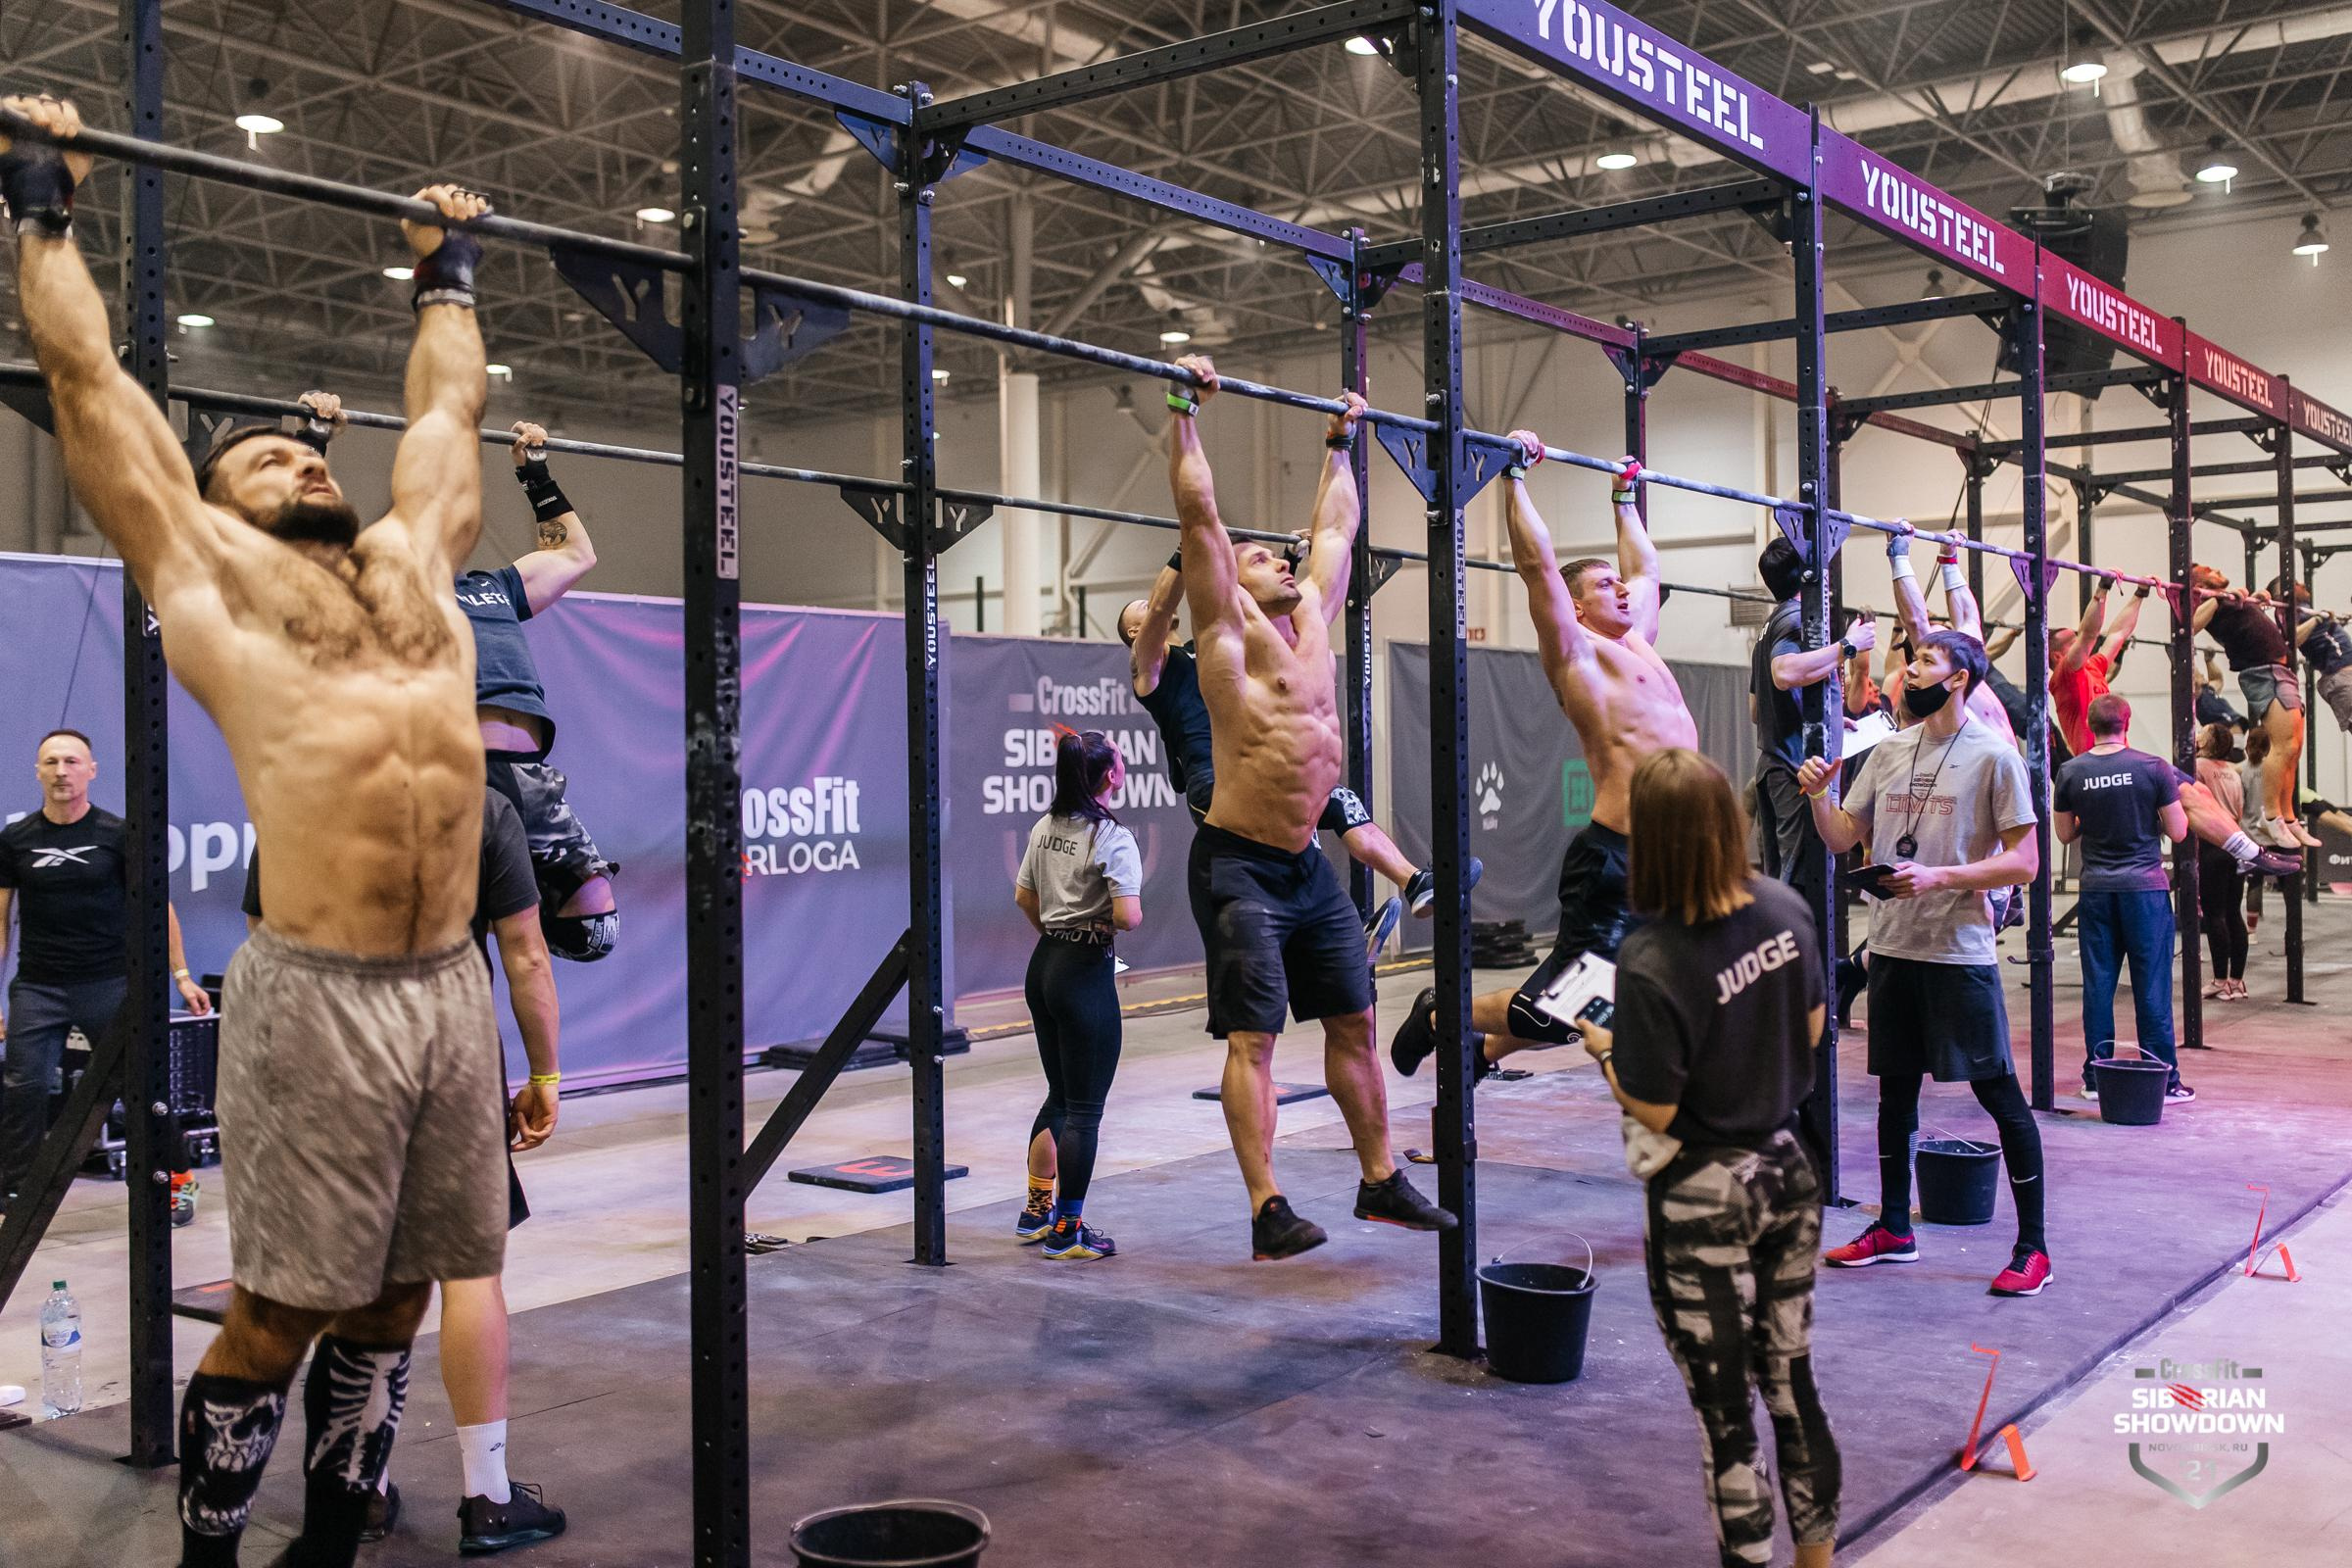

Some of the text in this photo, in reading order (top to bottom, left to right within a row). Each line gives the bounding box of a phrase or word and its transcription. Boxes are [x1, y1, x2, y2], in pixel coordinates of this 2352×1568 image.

[1534, 0, 1764, 150] YOUSTEEL
[1861, 159, 2005, 274] YOUSTEEL
[2066, 272, 2163, 355] YOUSTEEL
[2204, 347, 2274, 409] YOUSTEEL
[718, 393, 736, 571] YOUSTEEL
[1455, 512, 1466, 635] YOUSTEEL
[927, 556, 936, 668] YOUSTEEL
[1363, 599, 1372, 687] YOUSTEEL
[1037, 674, 1128, 715] CrossFit
[1004, 728, 1157, 767] SIBAN
[2082, 772, 2133, 791] JUDGE
[742, 776, 860, 839] ossFit
[982, 772, 1177, 814] SHOOWN
[746, 840, 860, 876] RLOGA
[1037, 834, 1078, 857] JUDGE
[1716, 929, 1800, 1005] JUDGE
